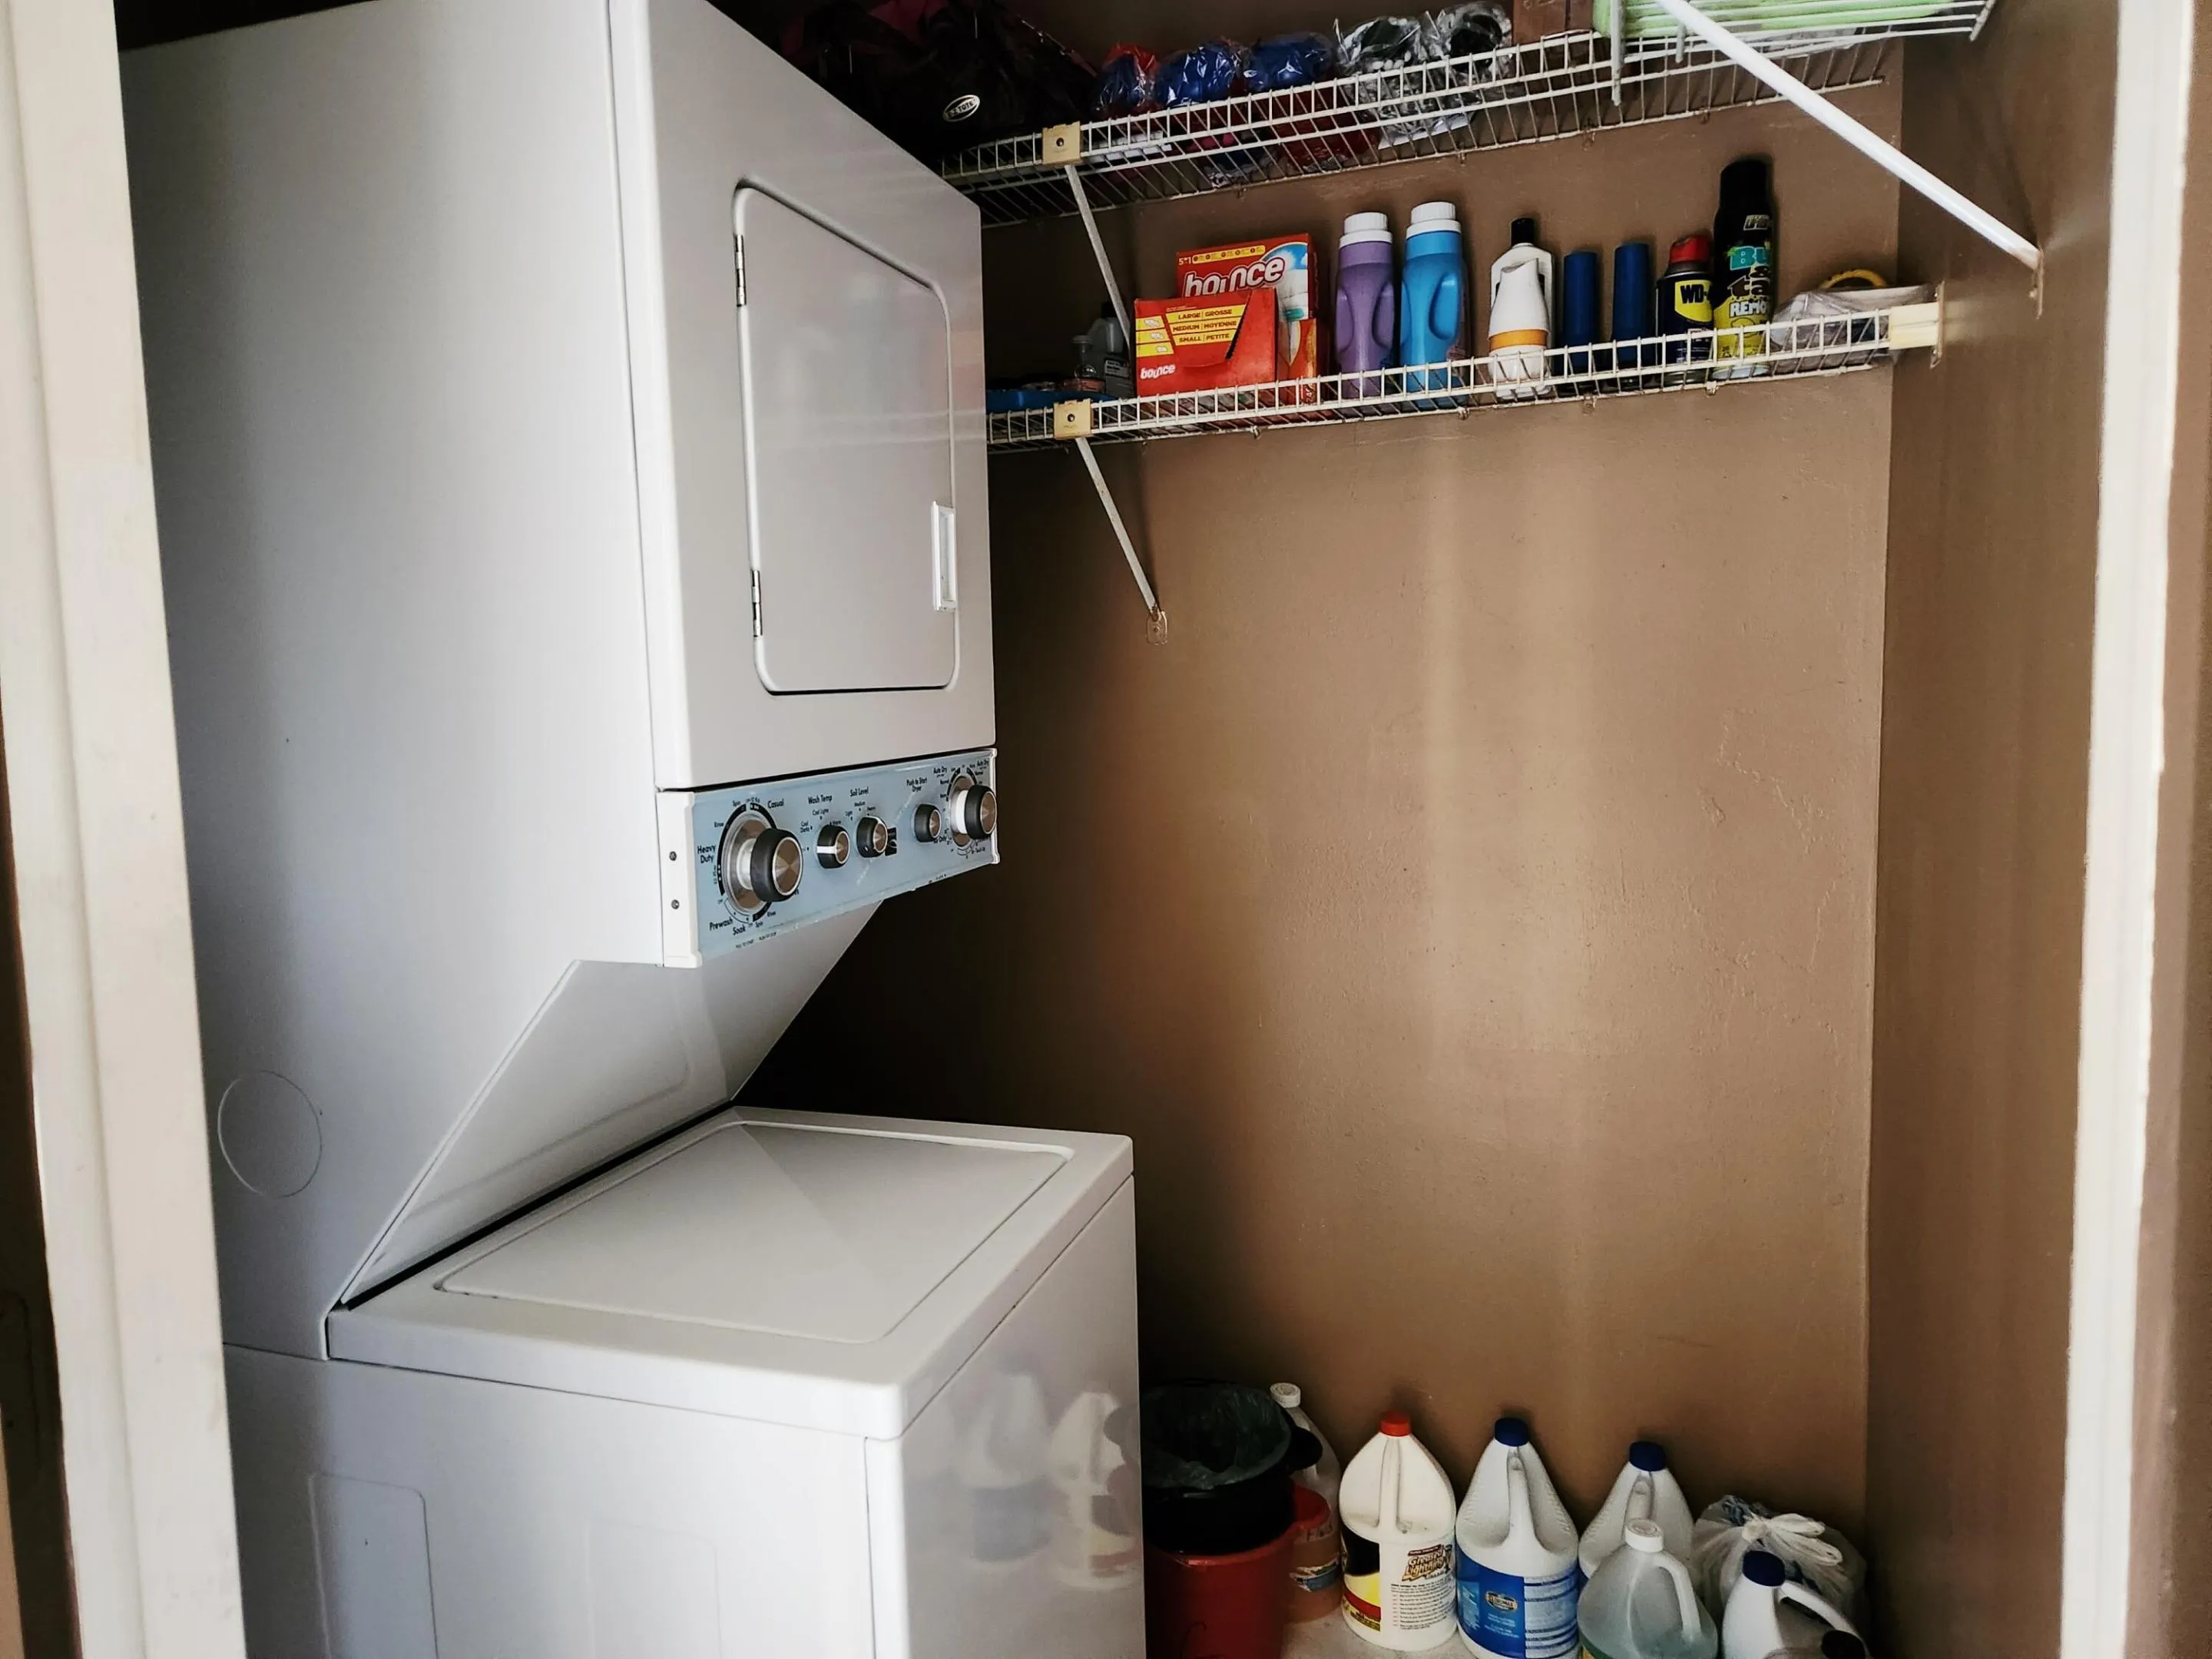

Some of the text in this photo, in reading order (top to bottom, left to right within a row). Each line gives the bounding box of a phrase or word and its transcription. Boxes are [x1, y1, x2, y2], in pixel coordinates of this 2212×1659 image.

[1680, 283, 1711, 304] WD-
[1730, 300, 1768, 316] REMO
[1140, 363, 1176, 379] bounce
[849, 786, 869, 797] Soil Level
[767, 798, 784, 809] Casual
[808, 794, 833, 805] Wash Temp
[697, 845, 717, 854] Heavy
[700, 855, 714, 863] Duty
[709, 916, 733, 931] Prewash
[733, 924, 746, 935] Soak
